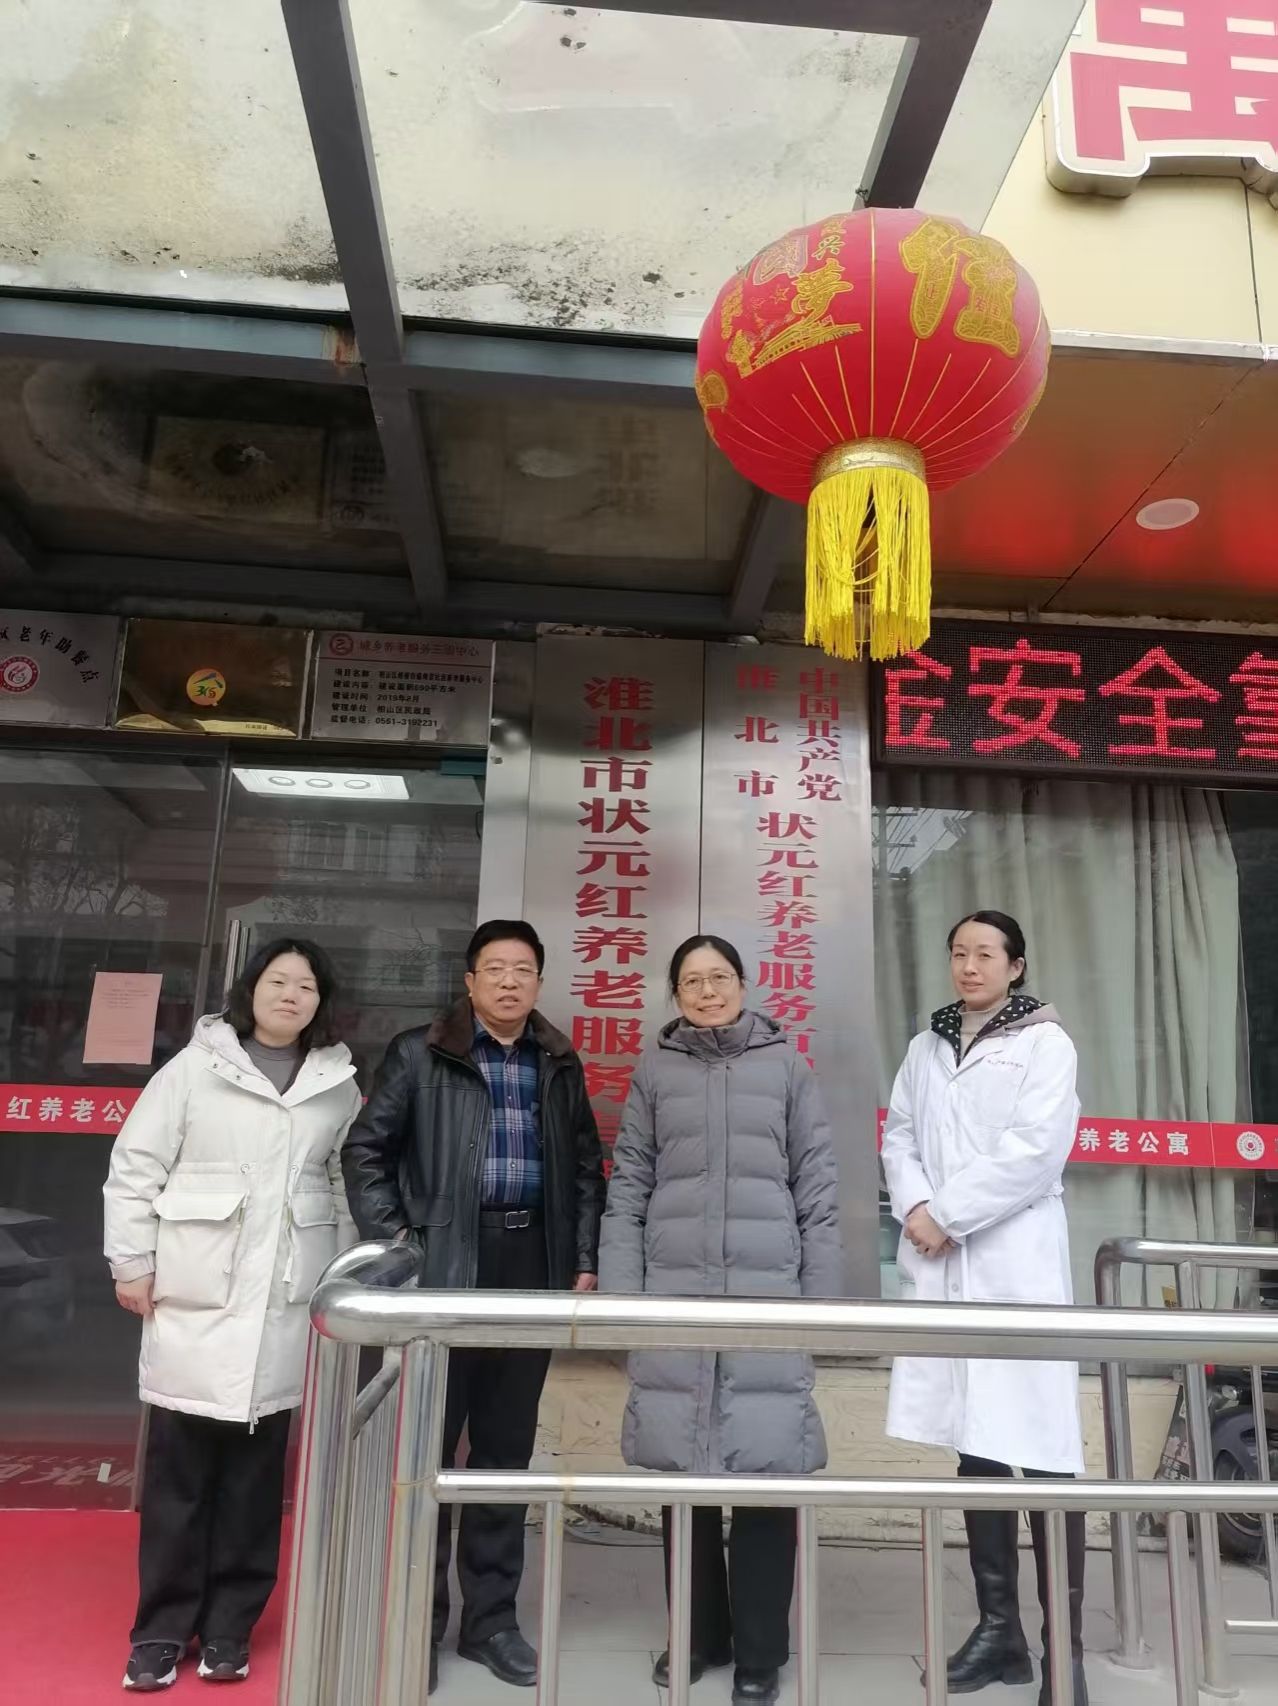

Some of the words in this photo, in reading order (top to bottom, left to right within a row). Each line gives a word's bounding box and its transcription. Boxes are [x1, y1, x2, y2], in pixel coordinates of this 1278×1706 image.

[797, 667, 842, 801] 中国共产党
[756, 811, 819, 1070] 状元红养老服务
[6, 1096, 127, 1123] 红养老公
[1078, 1128, 1189, 1156] 养老公寓
